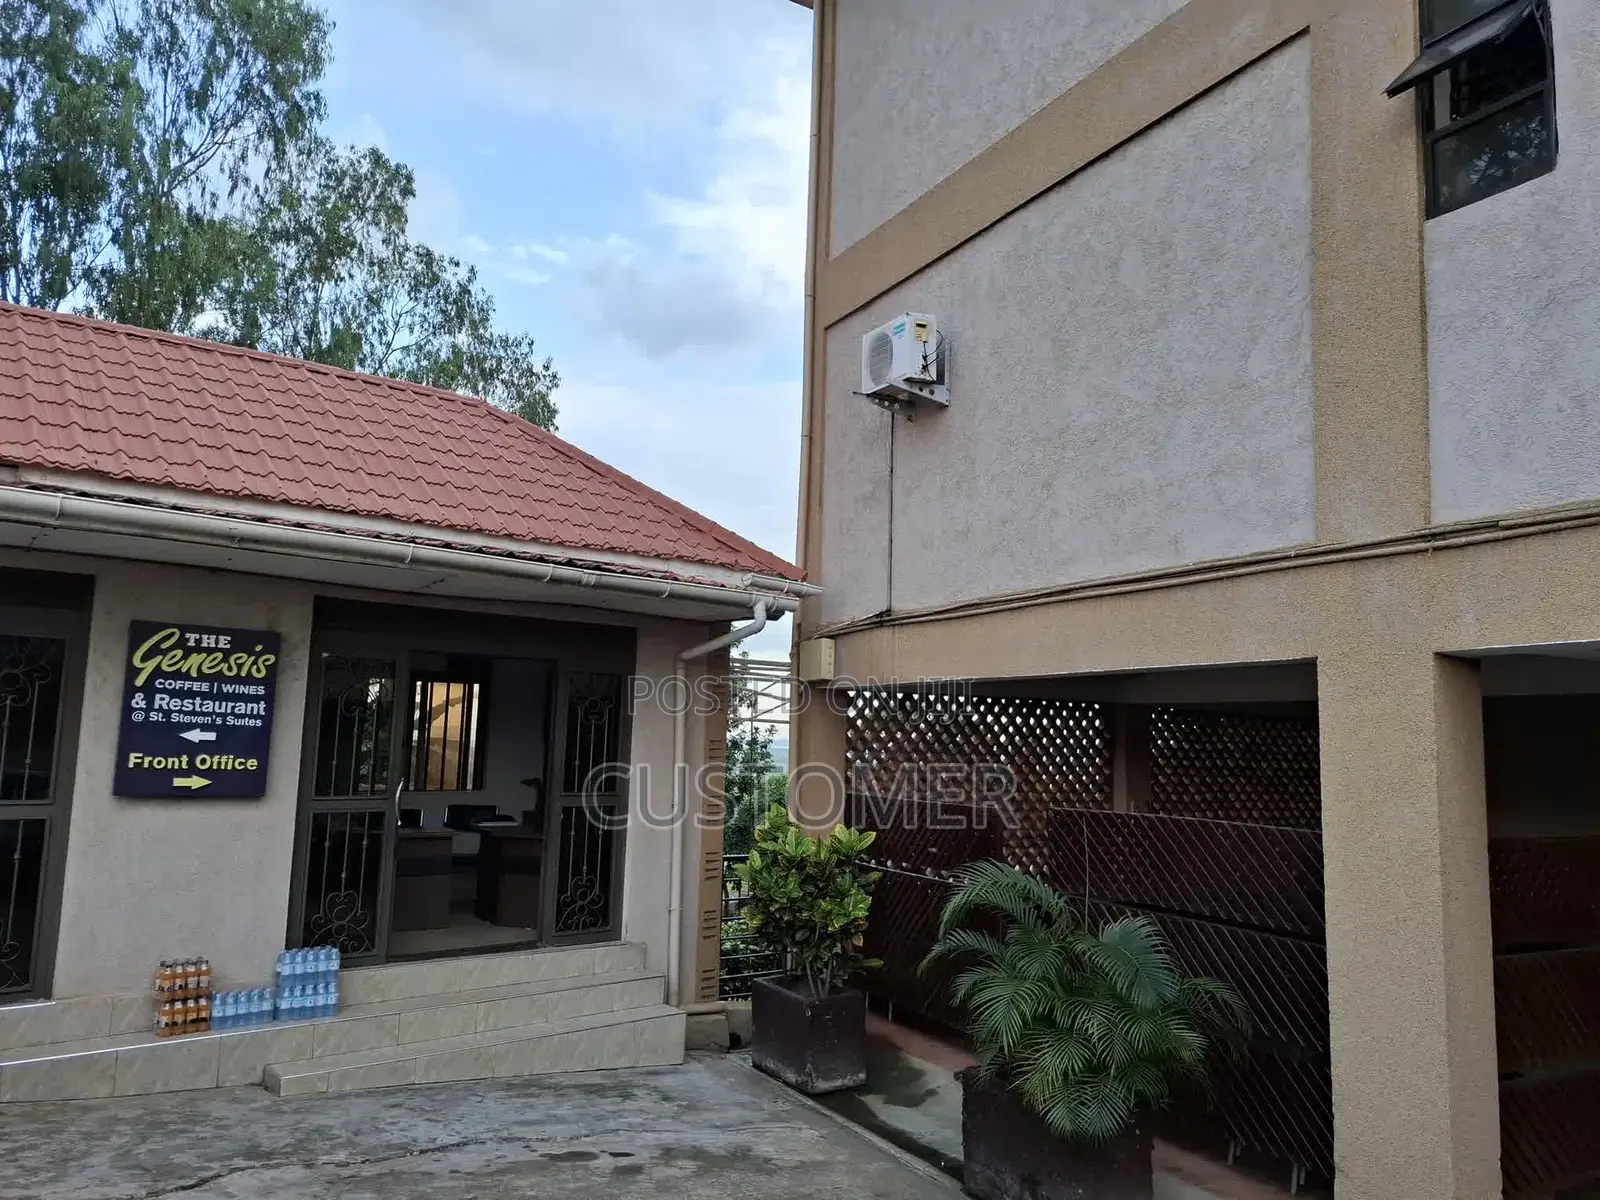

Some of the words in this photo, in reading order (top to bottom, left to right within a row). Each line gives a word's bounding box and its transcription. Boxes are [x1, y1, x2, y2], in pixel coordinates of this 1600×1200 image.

[185, 633, 231, 648] THE
[132, 628, 276, 687] Genesis
[155, 679, 210, 692] COFFEE
[222, 683, 265, 695] WINES
[131, 693, 147, 709] &
[154, 694, 266, 715] Restaurant
[131, 711, 145, 722] @
[149, 712, 166, 722] St.
[170, 713, 222, 725] Steven's
[226, 715, 262, 727] Suites
[128, 753, 189, 769] Front
[195, 754, 258, 770] Office
